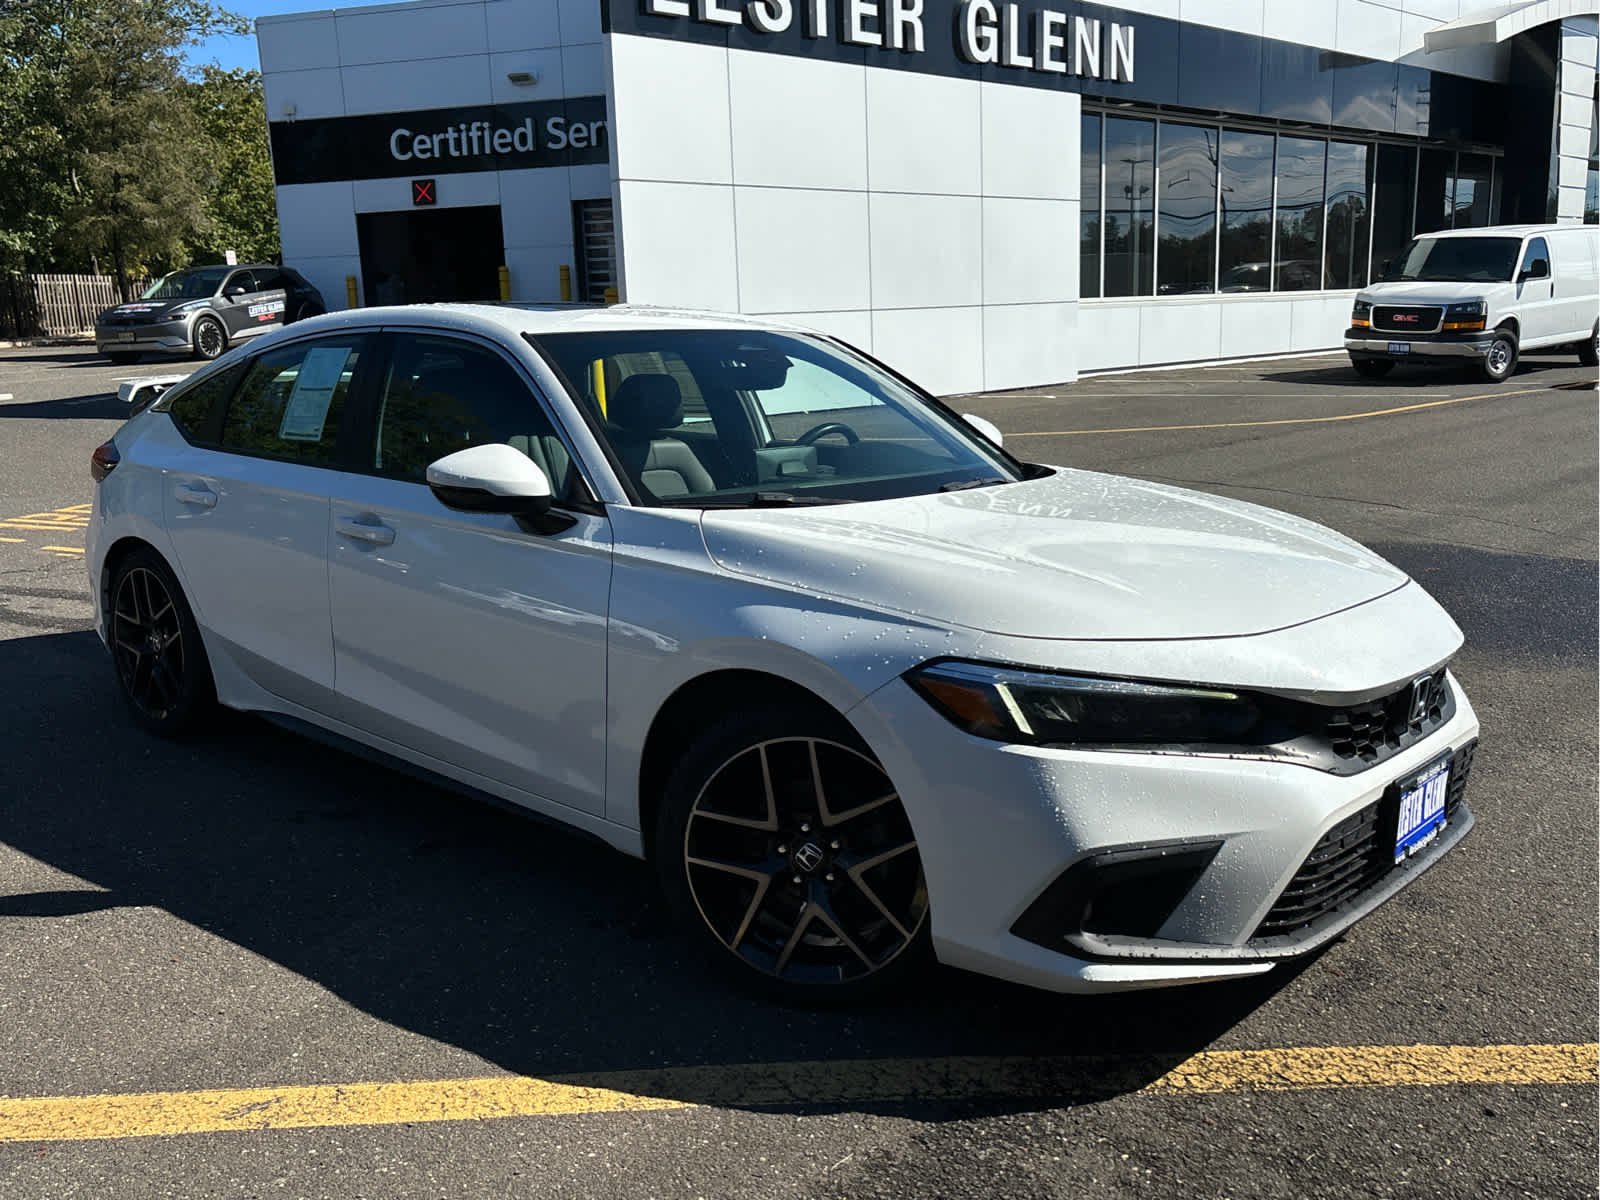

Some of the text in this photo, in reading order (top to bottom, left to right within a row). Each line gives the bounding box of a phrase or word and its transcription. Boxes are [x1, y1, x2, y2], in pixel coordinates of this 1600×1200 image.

[963, 0, 1135, 83] GLENN
[389, 117, 535, 161] Certified
[1393, 314, 1419, 322] GMC
